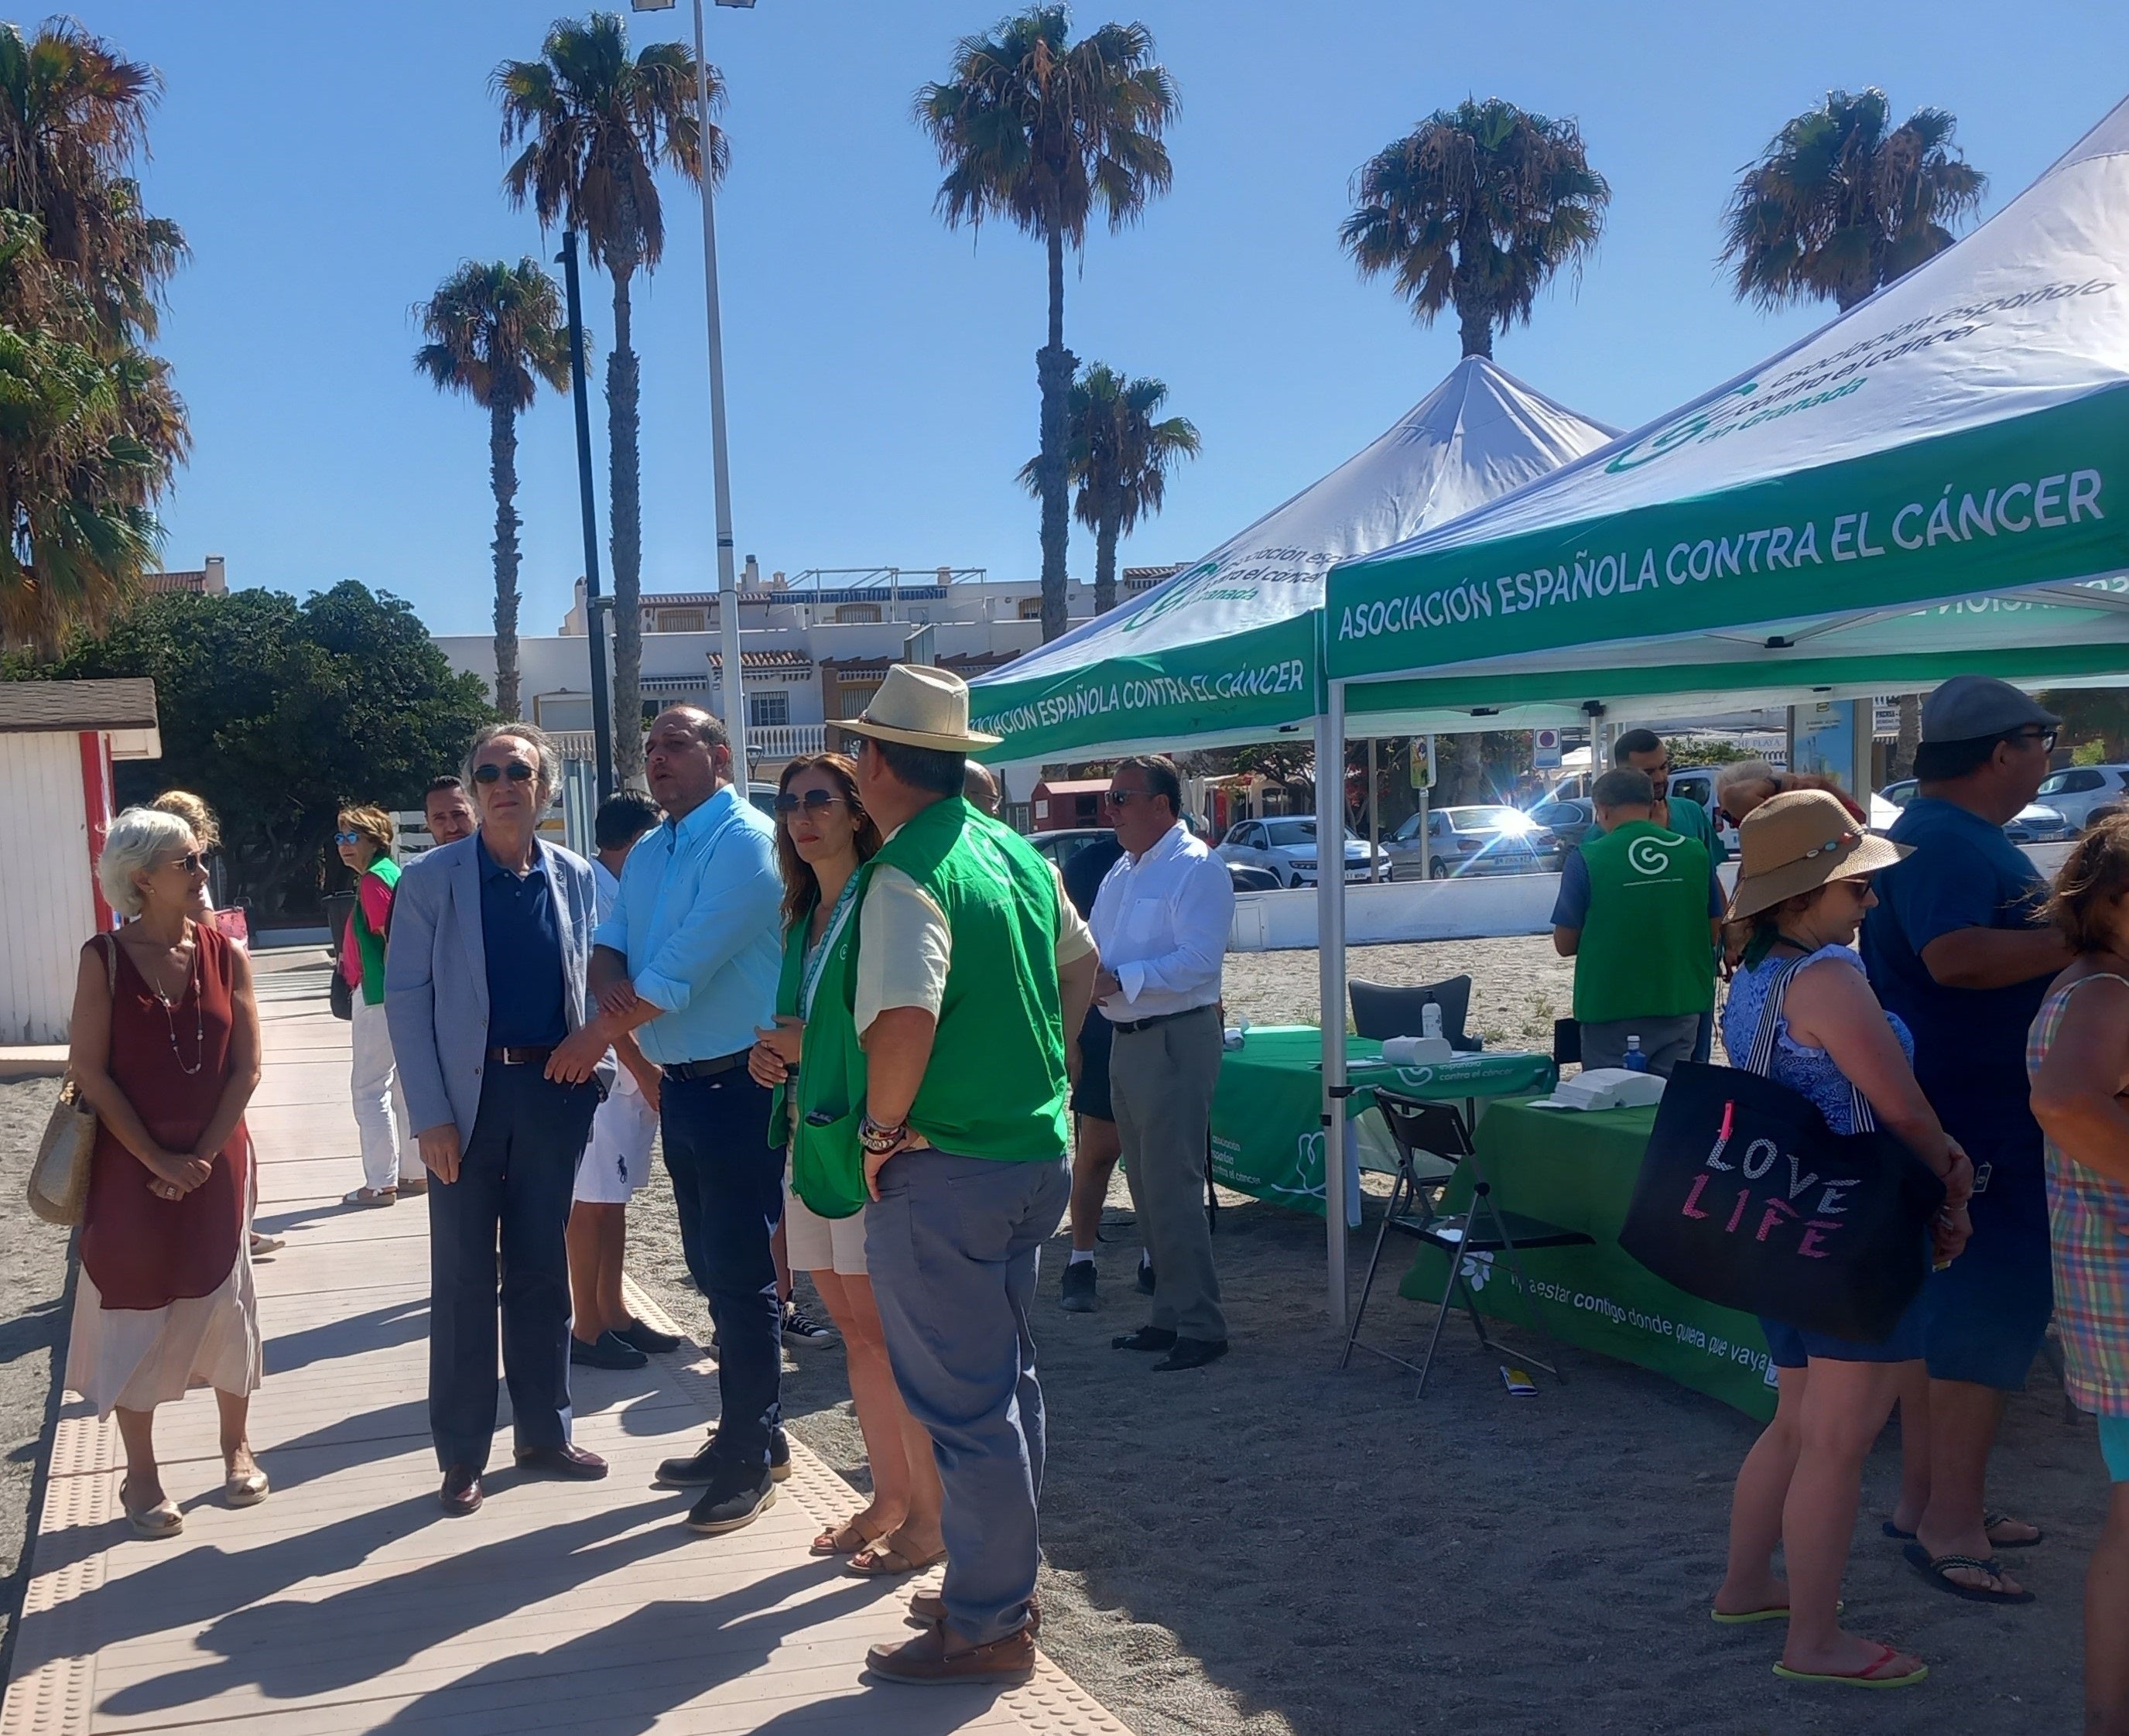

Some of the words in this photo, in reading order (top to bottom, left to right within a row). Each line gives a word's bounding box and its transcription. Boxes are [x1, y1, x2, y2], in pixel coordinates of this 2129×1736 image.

[1338, 577, 1492, 642] ASOCIACIÓN
[1496, 547, 1660, 615] ESPAÑOLA
[1665, 522, 1824, 586] CONTRA
[1830, 511, 1886, 563] EL
[1891, 469, 2105, 550] CÁNCER
[1037, 683, 1120, 728] ESPAÑOLA
[1122, 676, 1193, 710] CONTRA
[1190, 674, 1218, 702] EL
[1215, 659, 1304, 699] CÁNCER
[1705, 1128, 1863, 1215] LOVE
[1682, 1173, 1843, 1258] LIFE
[1573, 1293, 1627, 1324] contigo
[1628, 1308, 1673, 1336] donde
[1675, 1322, 1706, 1349] quiera
[1708, 1336, 1728, 1357] que
